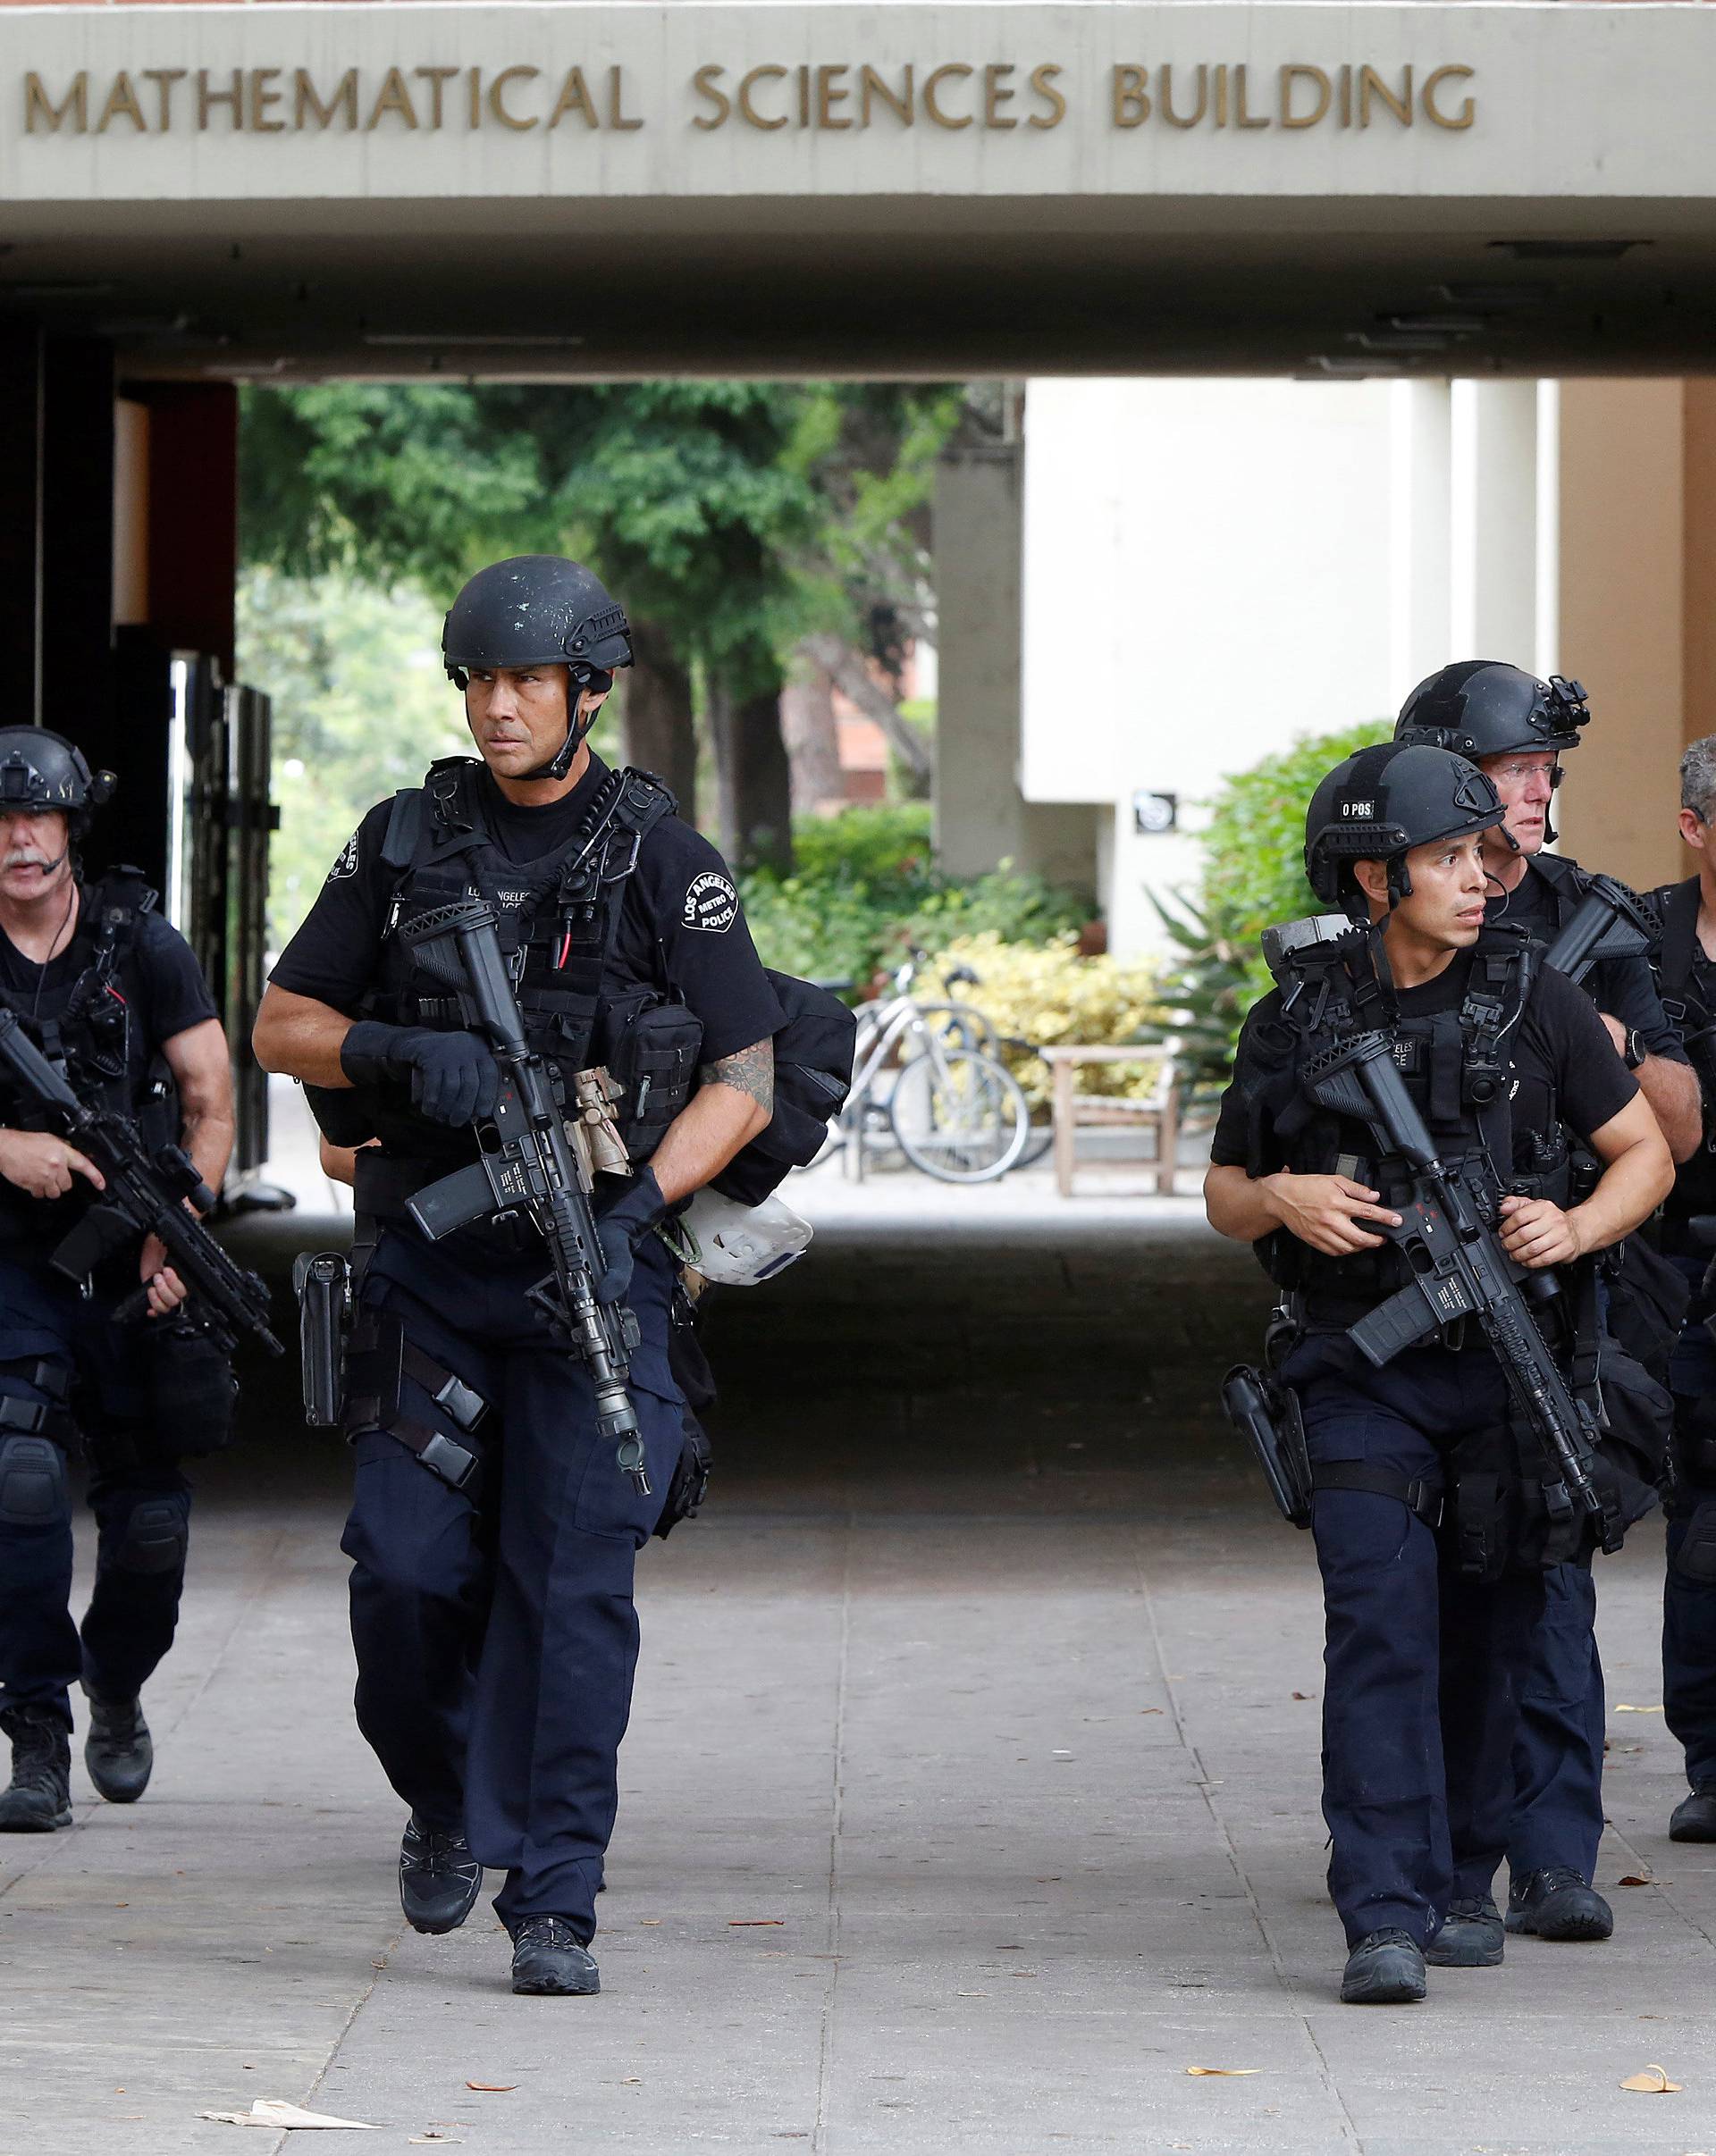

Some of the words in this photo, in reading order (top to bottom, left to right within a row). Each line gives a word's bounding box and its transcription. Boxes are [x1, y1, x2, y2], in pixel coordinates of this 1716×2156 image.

[24, 65, 644, 133] MATHEMATICAL
[693, 63, 1066, 130] SCIENCES
[1112, 63, 1476, 130] BUILDING
[1351, 802, 1371, 816] POS
[685, 896, 697, 921] LOS
[693, 876, 736, 902] ANGELES
[697, 894, 727, 913] METRO
[702, 906, 734, 928] POLICE
